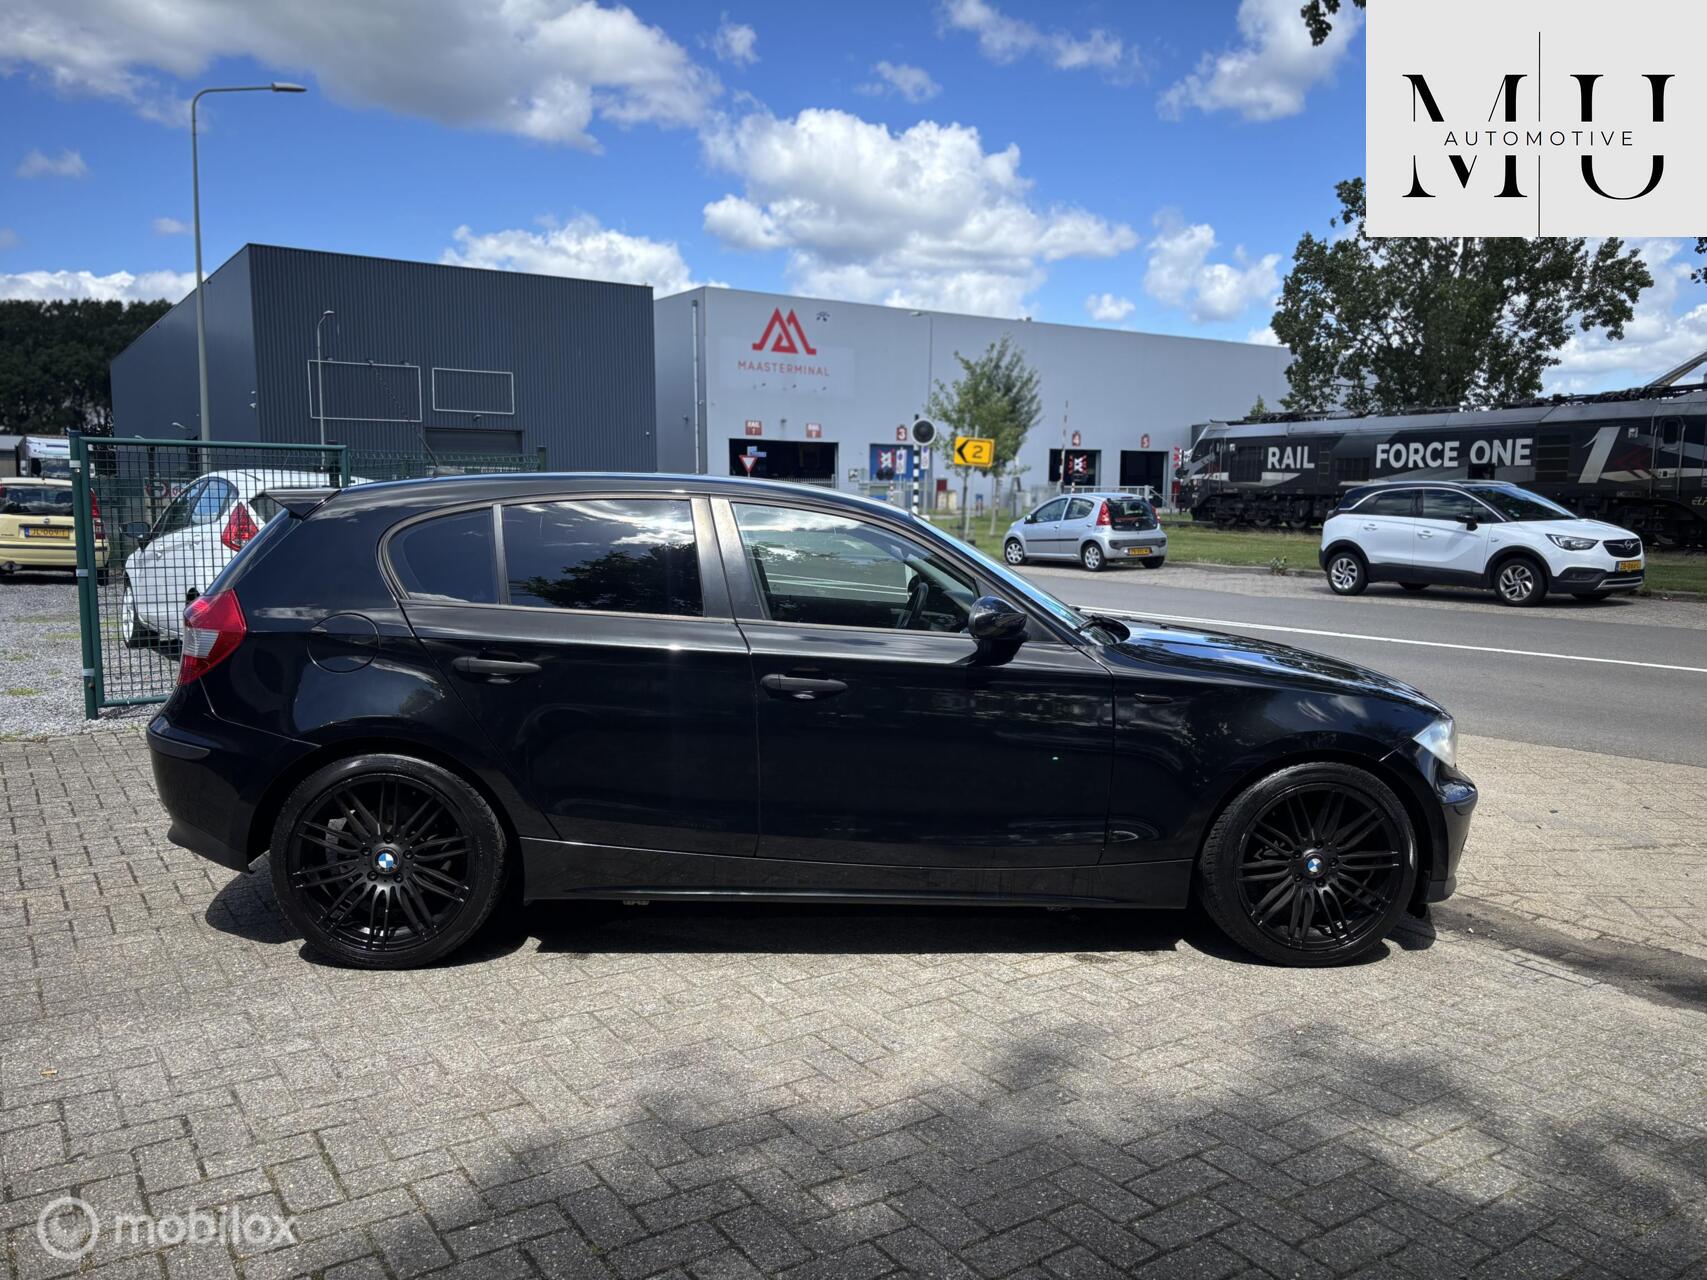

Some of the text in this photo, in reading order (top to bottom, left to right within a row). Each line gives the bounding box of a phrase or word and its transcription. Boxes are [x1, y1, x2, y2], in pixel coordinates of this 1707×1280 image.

[738, 361, 830, 377] MAASTERMINAL
[972, 445, 984, 459] 2
[1266, 437, 1534, 470] RAIL FORCE ONE
[1579, 427, 1622, 484] 1
